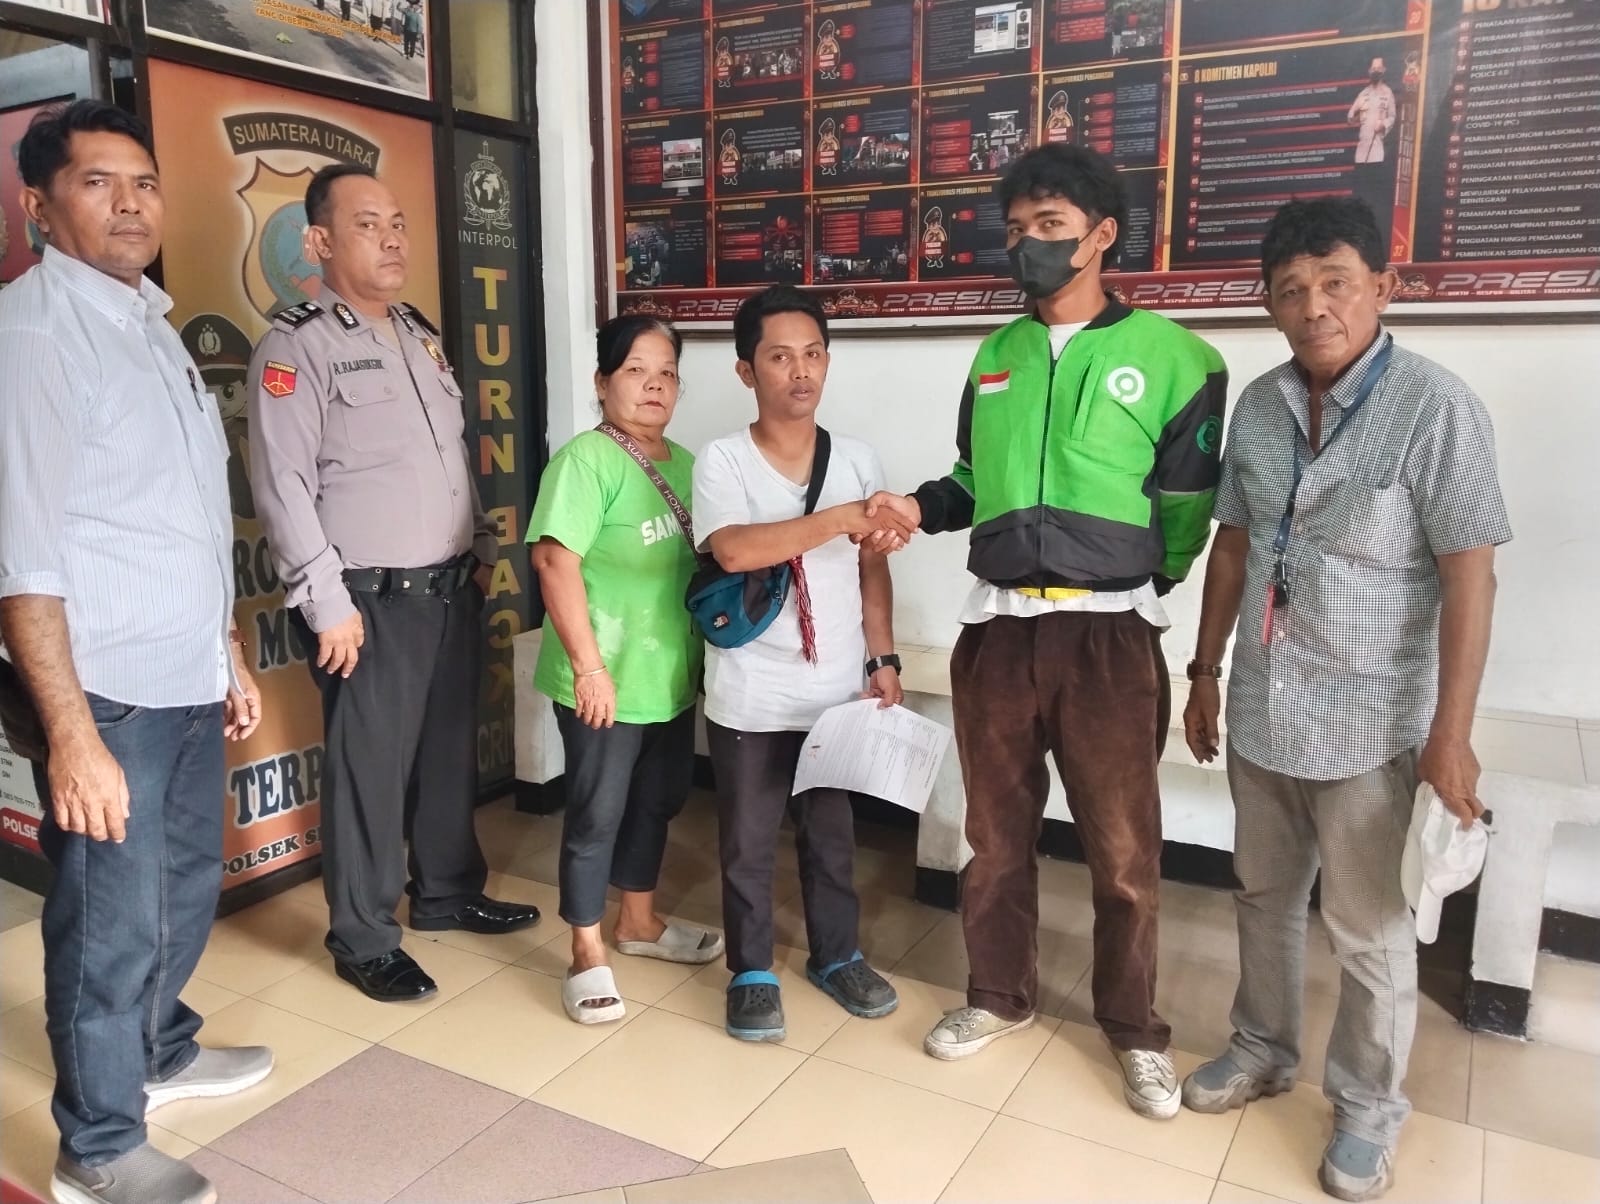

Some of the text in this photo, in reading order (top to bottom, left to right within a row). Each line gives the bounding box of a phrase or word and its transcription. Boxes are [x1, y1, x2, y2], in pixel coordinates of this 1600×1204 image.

[1201, 65, 1243, 83] KOMITMEN
[1243, 61, 1278, 79] KAPOLRI
[1467, 98, 1520, 108] PENINGKATAN
[1466, 111, 1516, 121] PEMANTAPAN
[1544, 127, 1584, 136] NASIONAL
[233, 122, 374, 169] SUMATERA UTARA
[1504, 143, 1548, 153] KEAMANAN
[1507, 157, 1562, 167] PENANGANAN
[1461, 175, 1512, 184] PENINGKATAN
[1512, 185, 1557, 194] PELAYANAN
[1458, 210, 1507, 218] PEMANTAPAN
[1508, 206, 1556, 215] KOMUNIKASI
[1457, 224, 1509, 232] PENGAWASAN
[1548, 219, 1586, 227] TERHADAP
[458, 230, 518, 249] INTERPOL
[1528, 233, 1583, 241] PENGAWASAN
[1456, 249, 1506, 258] PEMBENTUKAN
[1507, 248, 1531, 256] SISTEM
[1532, 246, 1586, 255] PENGAWASAN
[1132, 280, 1269, 299] PRESI
[882, 289, 1028, 308] PRESISI
[472, 266, 515, 475] TURN
[624, 441, 650, 468] XUAN
[664, 490, 688, 522] HONG
[2, 815, 39, 841] POLSE
